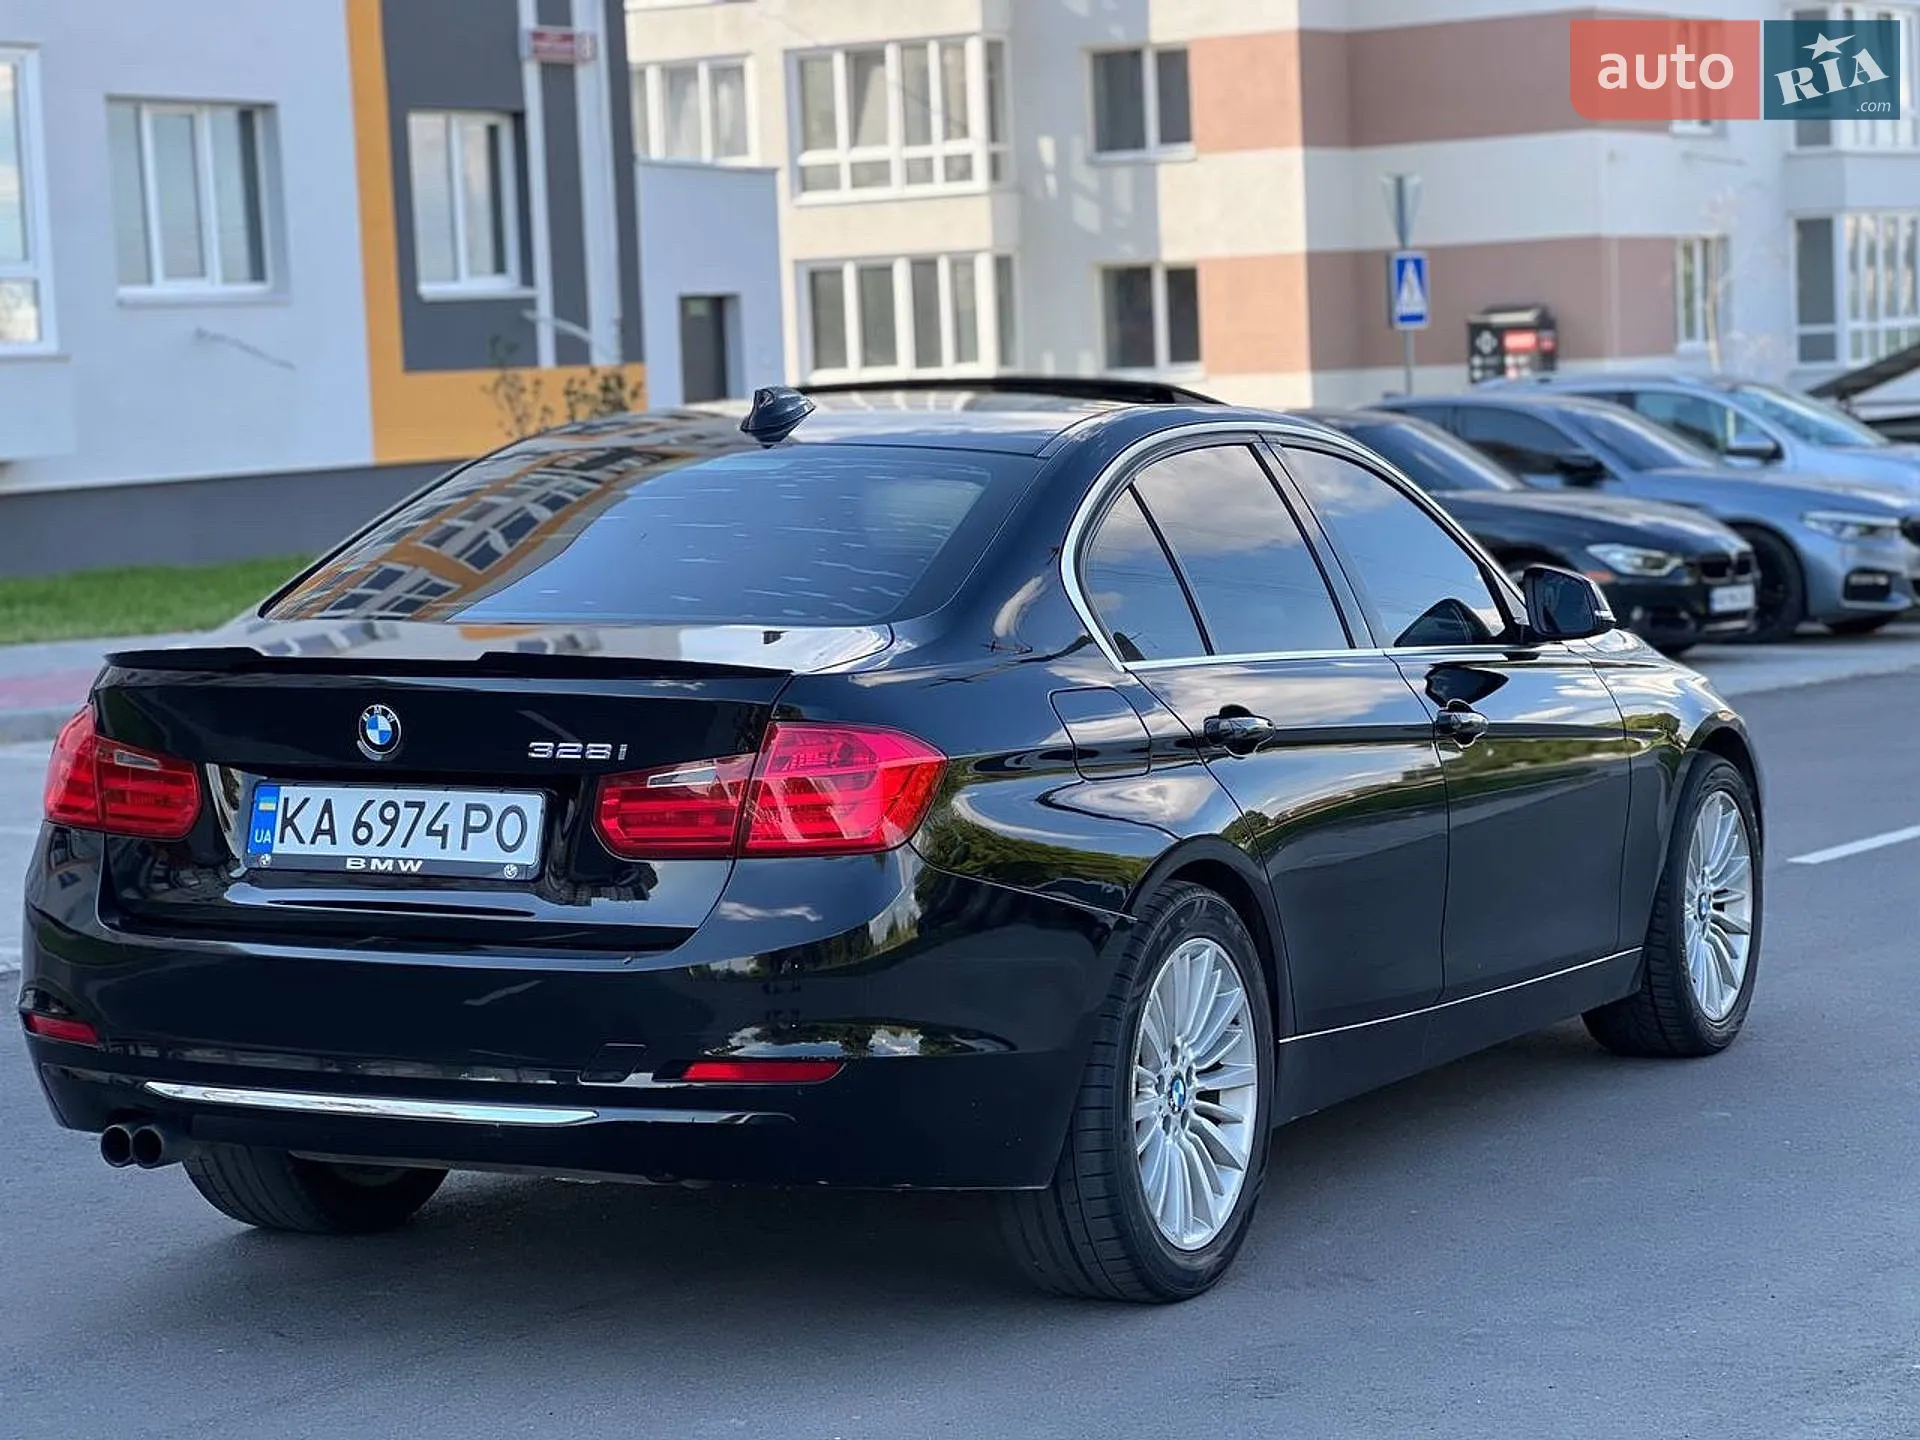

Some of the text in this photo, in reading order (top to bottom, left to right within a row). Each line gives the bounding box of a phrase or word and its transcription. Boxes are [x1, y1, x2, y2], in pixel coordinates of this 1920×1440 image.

[362, 705, 396, 722] BMW
[278, 797, 528, 853] KA 6974 PO
[255, 829, 272, 844] UA
[346, 857, 423, 872] BMW
